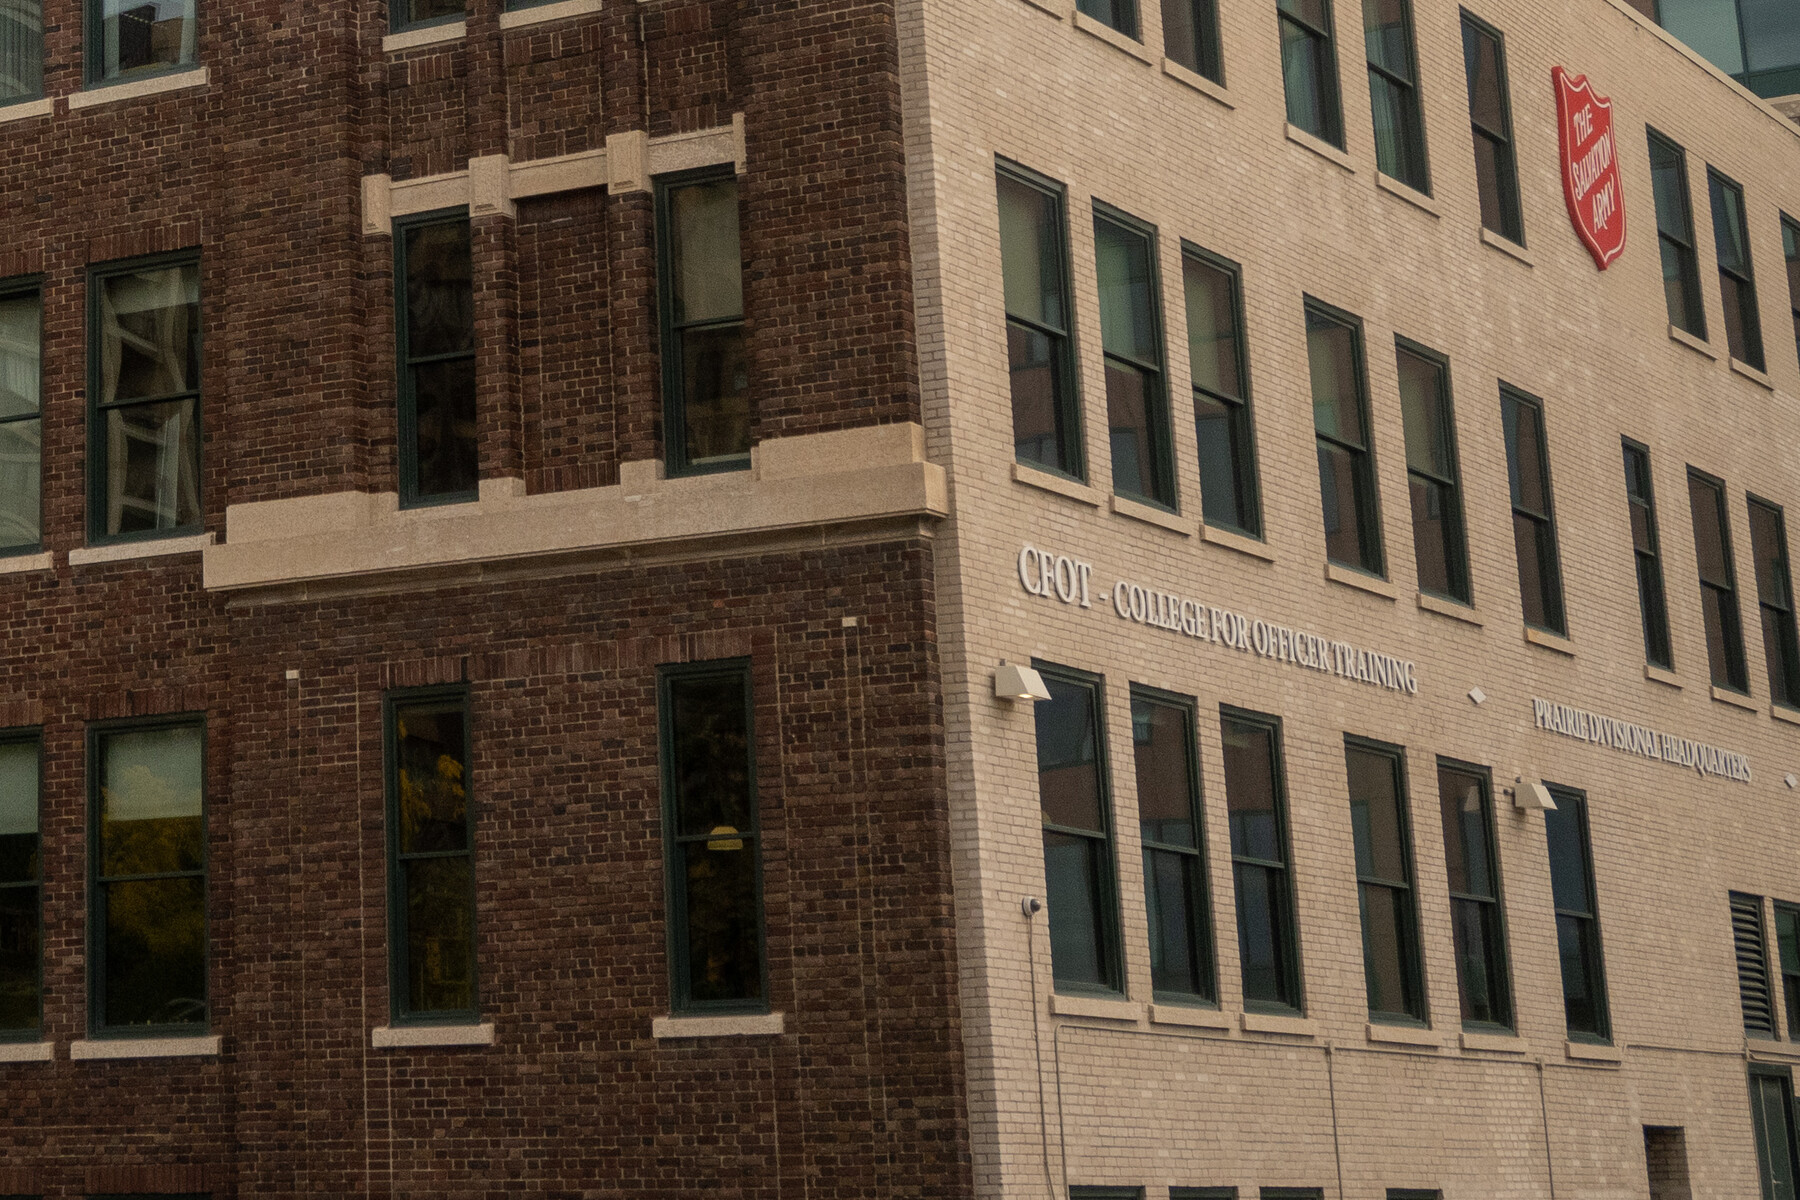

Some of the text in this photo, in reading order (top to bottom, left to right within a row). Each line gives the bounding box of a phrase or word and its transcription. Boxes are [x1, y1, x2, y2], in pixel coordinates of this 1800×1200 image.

[1574, 103, 1592, 146] THE
[1572, 126, 1612, 200] SALVATION
[1592, 174, 1616, 233] ARMY
[1019, 545, 1092, 608] CFOT
[1114, 581, 1208, 639] COLLEGE
[1210, 608, 1249, 649] FOR
[1251, 620, 1330, 671] OFFICER
[1331, 641, 1417, 694] TRAINING
[1533, 698, 1751, 782] PRAIRIE DIVISIONAL HEADQUARTERS
